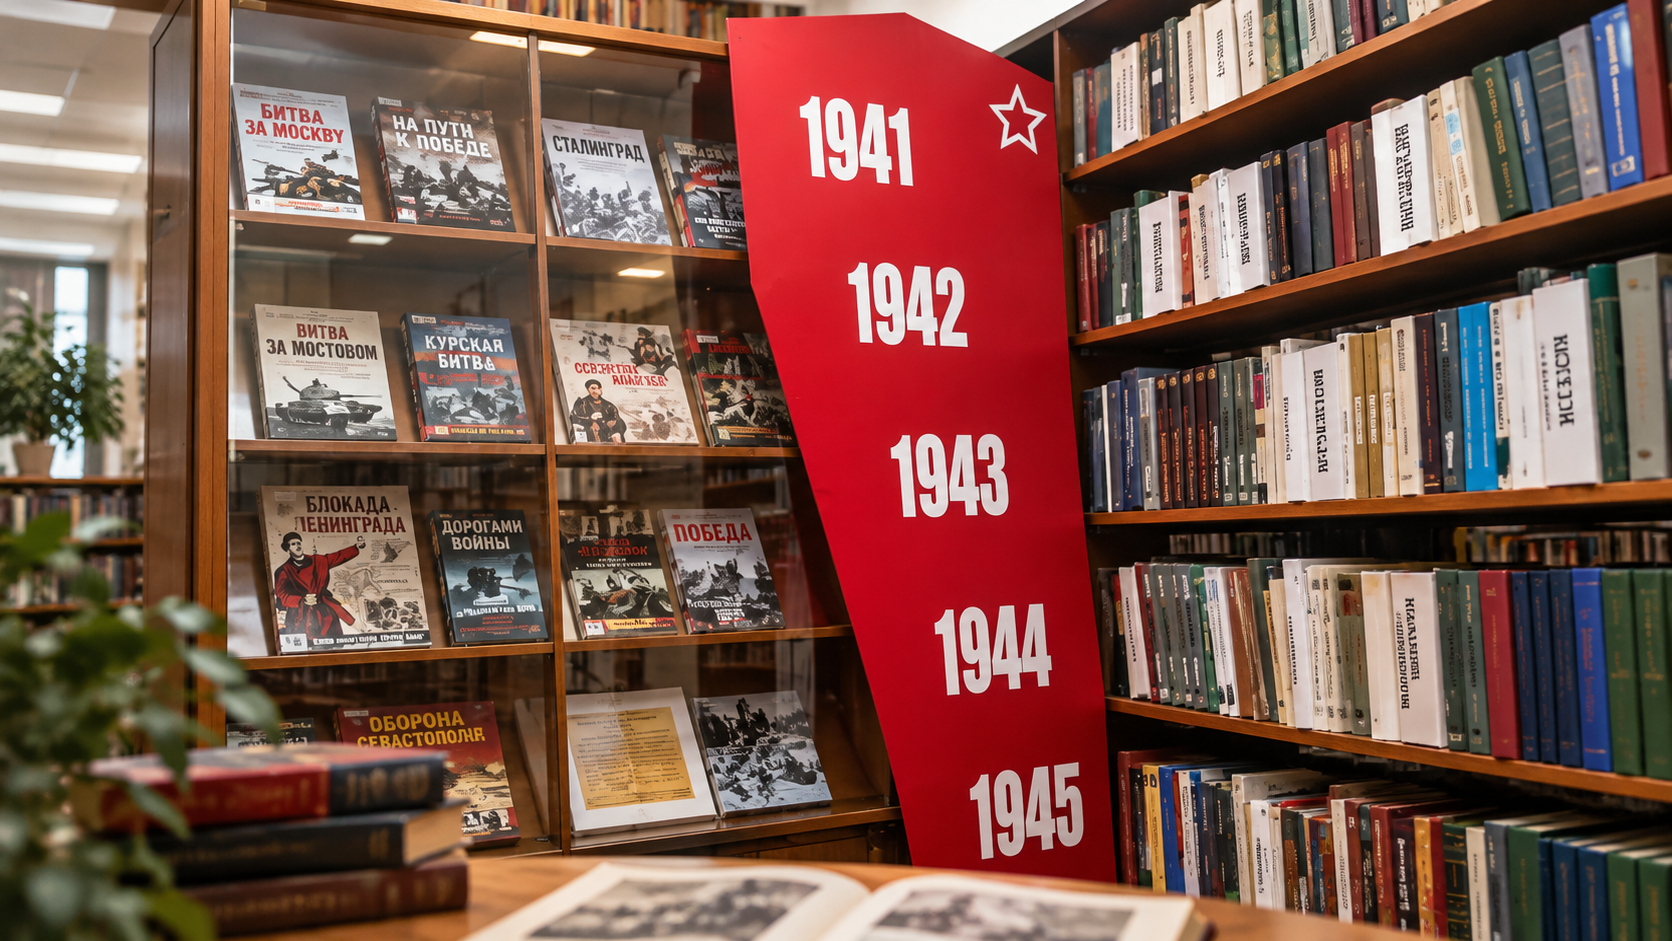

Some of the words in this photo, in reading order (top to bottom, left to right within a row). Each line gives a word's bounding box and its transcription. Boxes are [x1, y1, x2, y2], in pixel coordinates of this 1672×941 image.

[260, 102, 325, 125] БИТВА
[392, 114, 419, 133] НА
[244, 118, 268, 137] ЗА
[272, 122, 345, 144] МОСКВУ
[799, 95, 914, 187] 1941
[395, 130, 411, 148] К
[416, 133, 493, 159] ПОБЕДЕ
[551, 135, 646, 164] СТАЛИНГРАД
[847, 261, 969, 348] 1942
[266, 338, 288, 356] ЗА
[291, 339, 378, 361] МОСТОВОМ
[424, 334, 505, 353] КУРСКАЯ
[890, 433, 1010, 518] 1943
[305, 495, 391, 515] БЛОКАДА
[441, 519, 524, 536] ДОРОГАМИ
[672, 522, 753, 544] ПОБЕДА
[451, 533, 511, 551] ВОЙНЫ
[933, 603, 1053, 696] 1944
[368, 710, 466, 733] ОБОРОНА
[969, 761, 1085, 860] 1945
